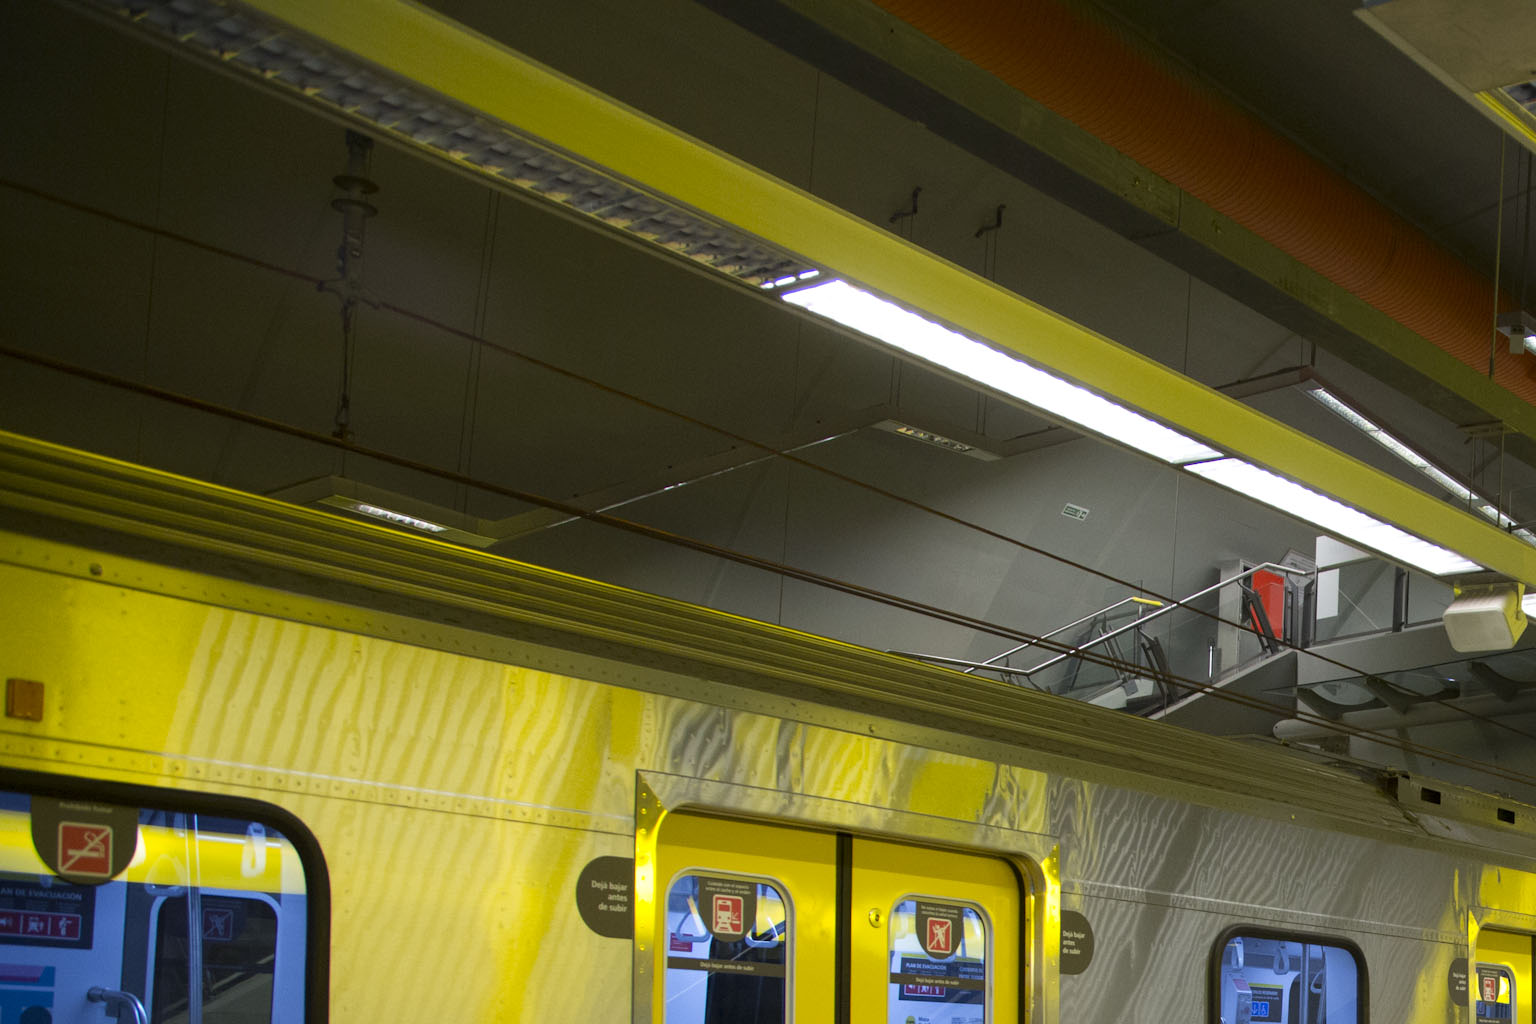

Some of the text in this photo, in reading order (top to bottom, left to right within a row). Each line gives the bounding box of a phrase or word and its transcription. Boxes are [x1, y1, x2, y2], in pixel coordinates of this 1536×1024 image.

[609, 881, 628, 893] bajar
[607, 893, 628, 902] antes
[598, 902, 628, 912] de subir
